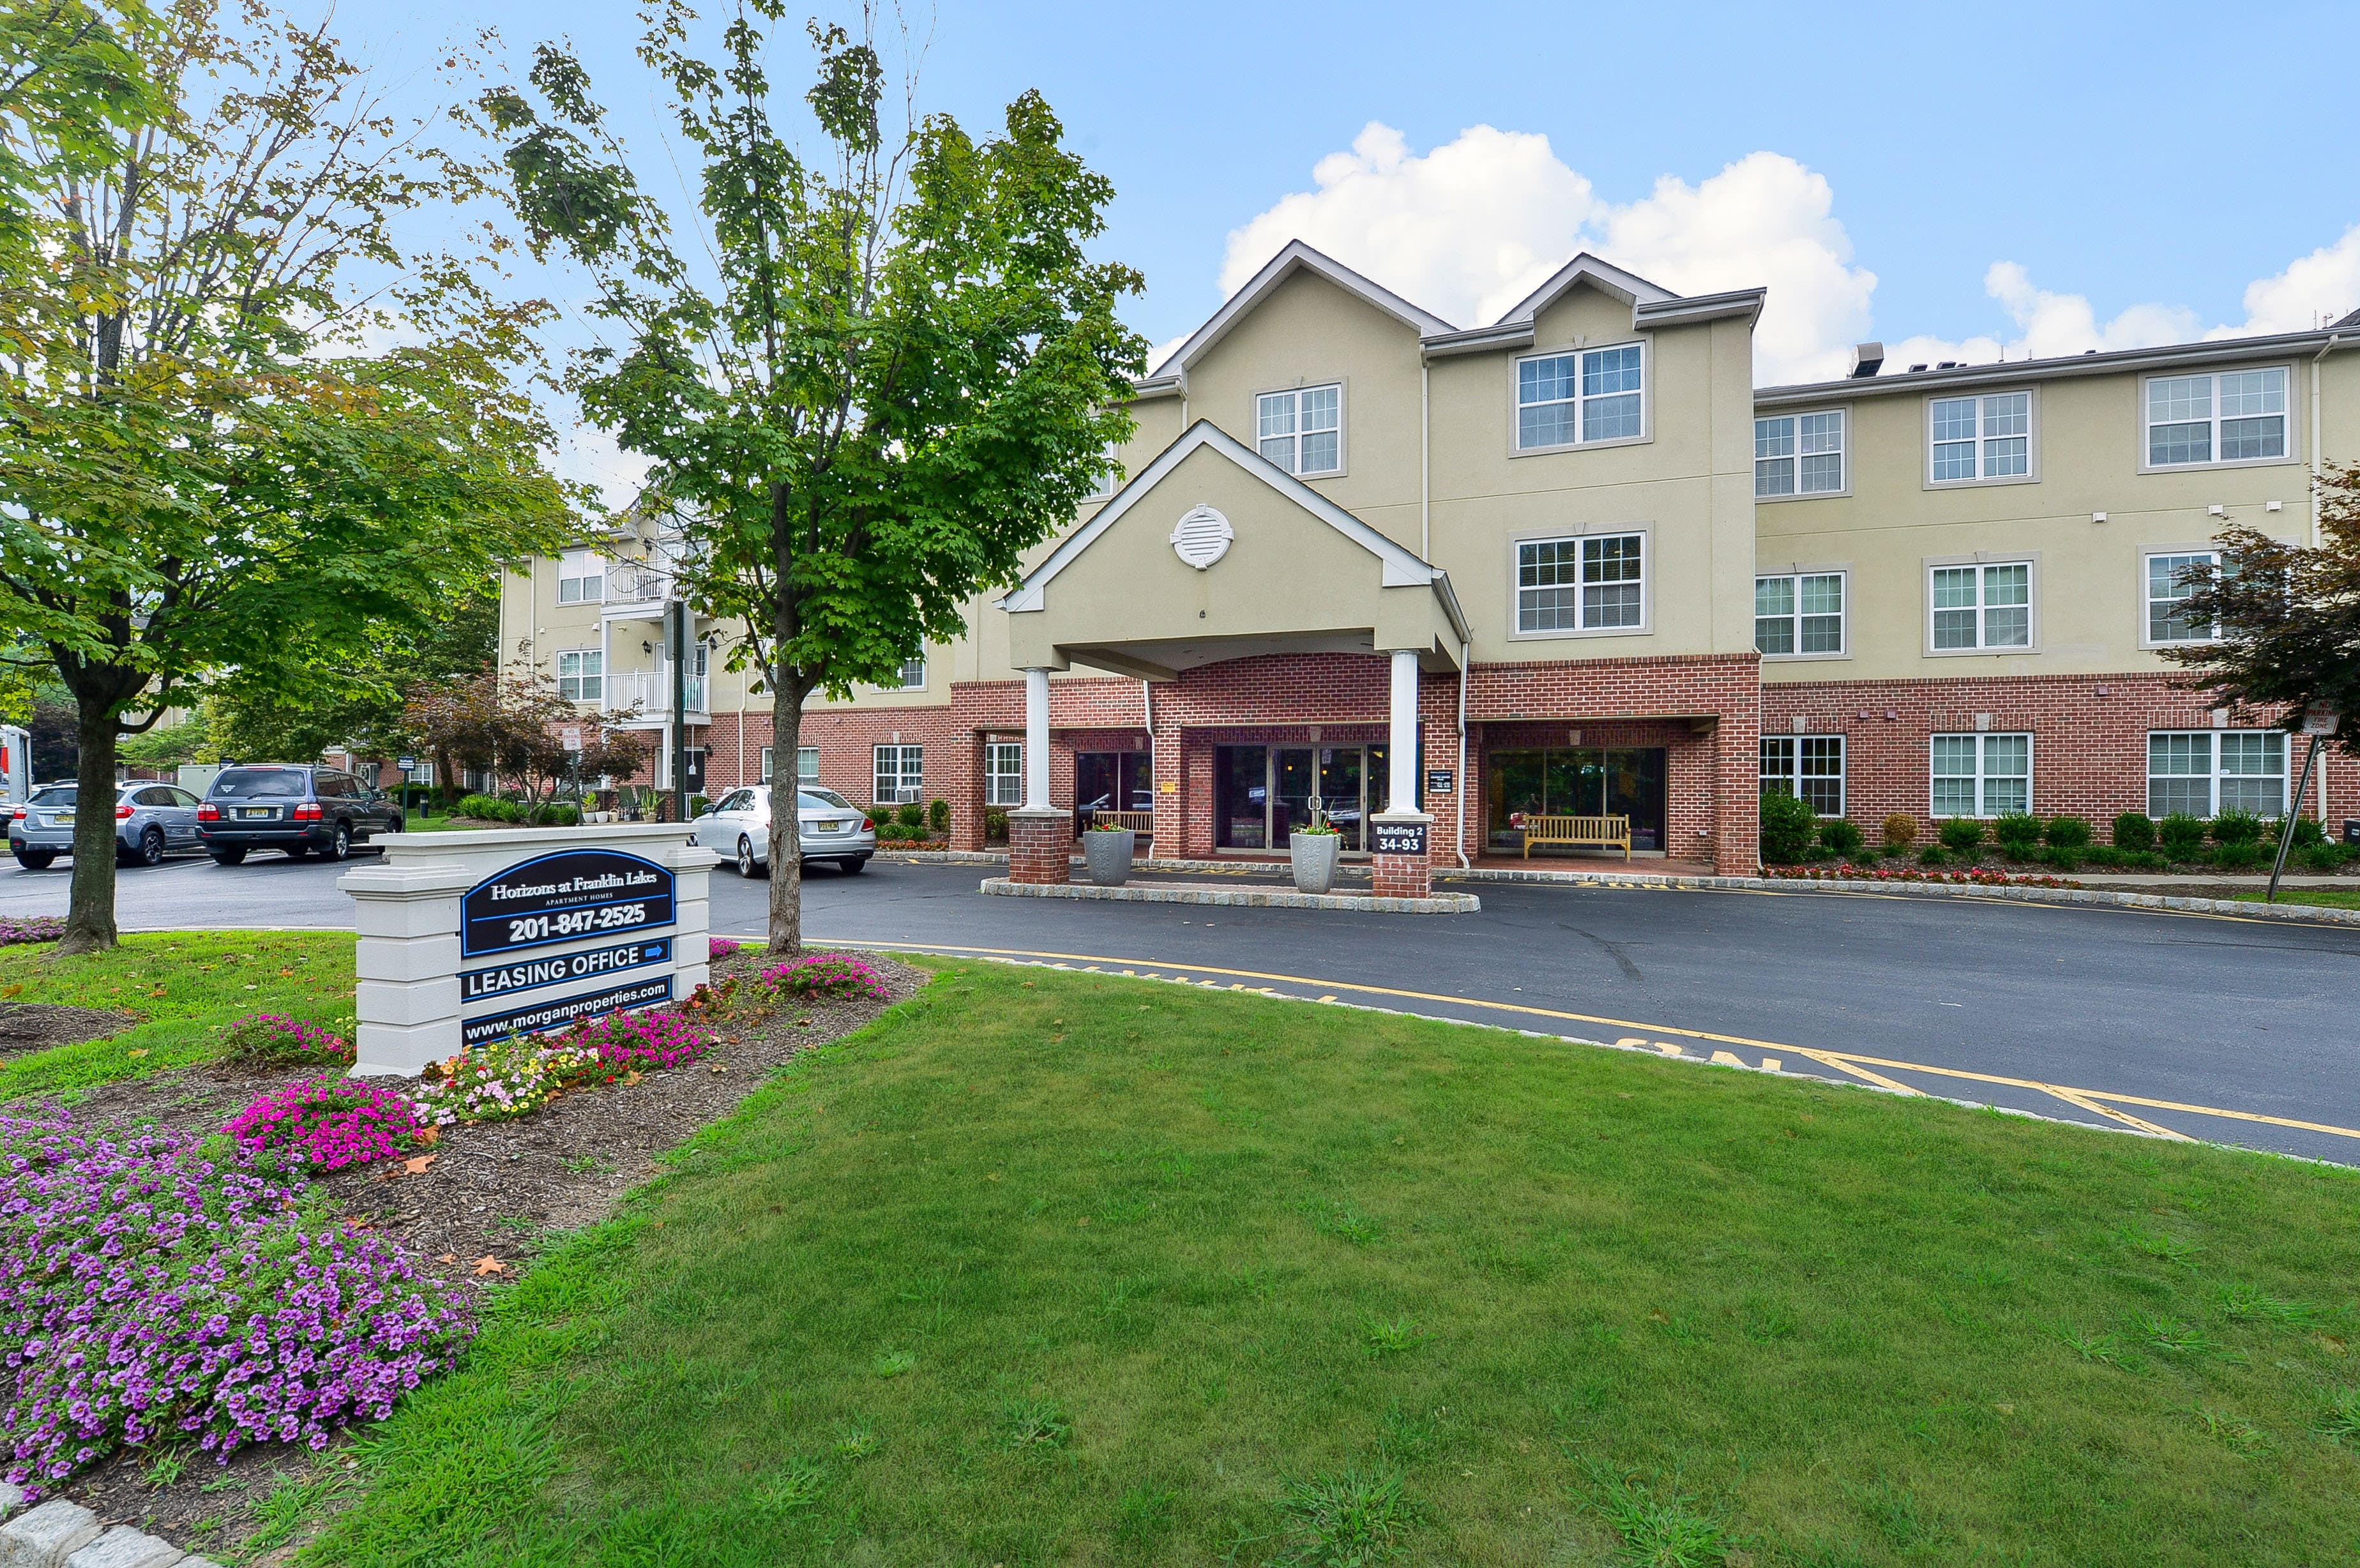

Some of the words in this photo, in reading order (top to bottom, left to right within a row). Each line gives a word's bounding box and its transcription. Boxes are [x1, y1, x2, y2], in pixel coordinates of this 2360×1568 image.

[1377, 826, 1414, 837] Building
[1416, 827, 1423, 835] 2
[1379, 838, 1419, 850] 34-93
[490, 884, 556, 901] Horizons
[557, 883, 571, 893] at
[573, 873, 624, 891] Franklin
[625, 870, 657, 885] Lakes
[545, 895, 587, 906] APARTMENT
[589, 892, 613, 901] HOMES
[509, 903, 646, 942] 201-847-2525
[469, 960, 566, 995] LEASING
[571, 946, 639, 974] OFFICE
[465, 983, 665, 1039] www.morganproperties.com
